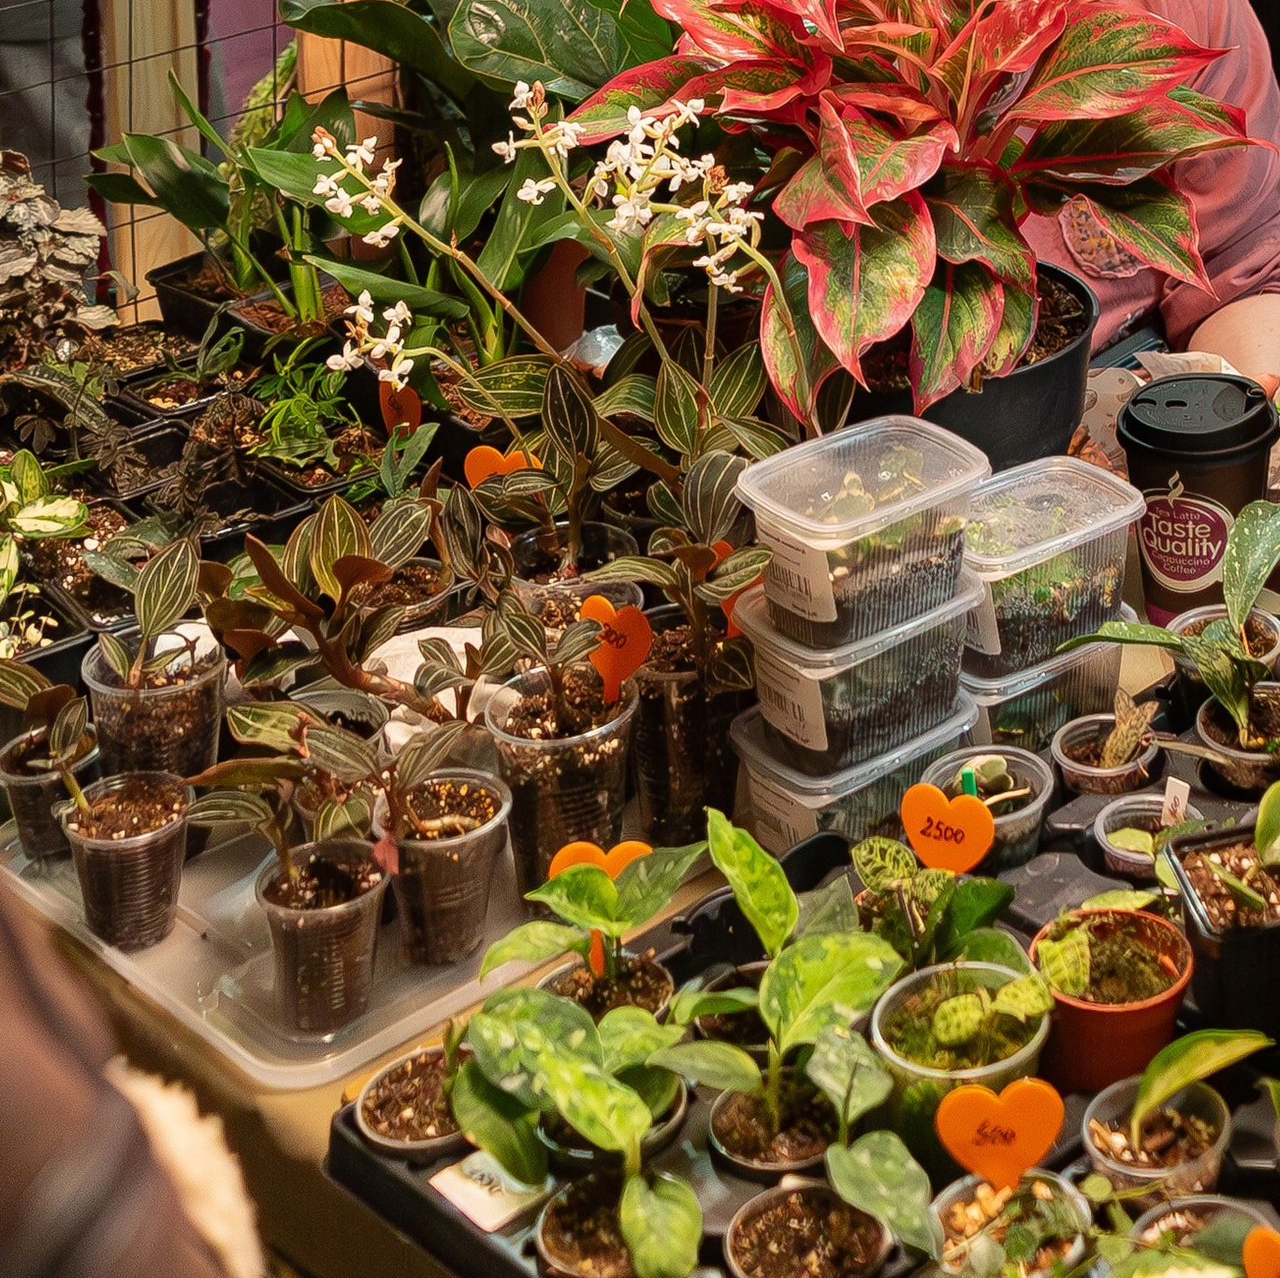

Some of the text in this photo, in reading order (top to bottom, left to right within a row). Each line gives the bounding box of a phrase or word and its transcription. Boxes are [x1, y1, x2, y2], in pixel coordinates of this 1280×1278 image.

[1148, 511, 1211, 538] Taste
[1143, 527, 1222, 560] Quality
[1163, 562, 1197, 575] Coffee
[919, 816, 966, 845] 2500
